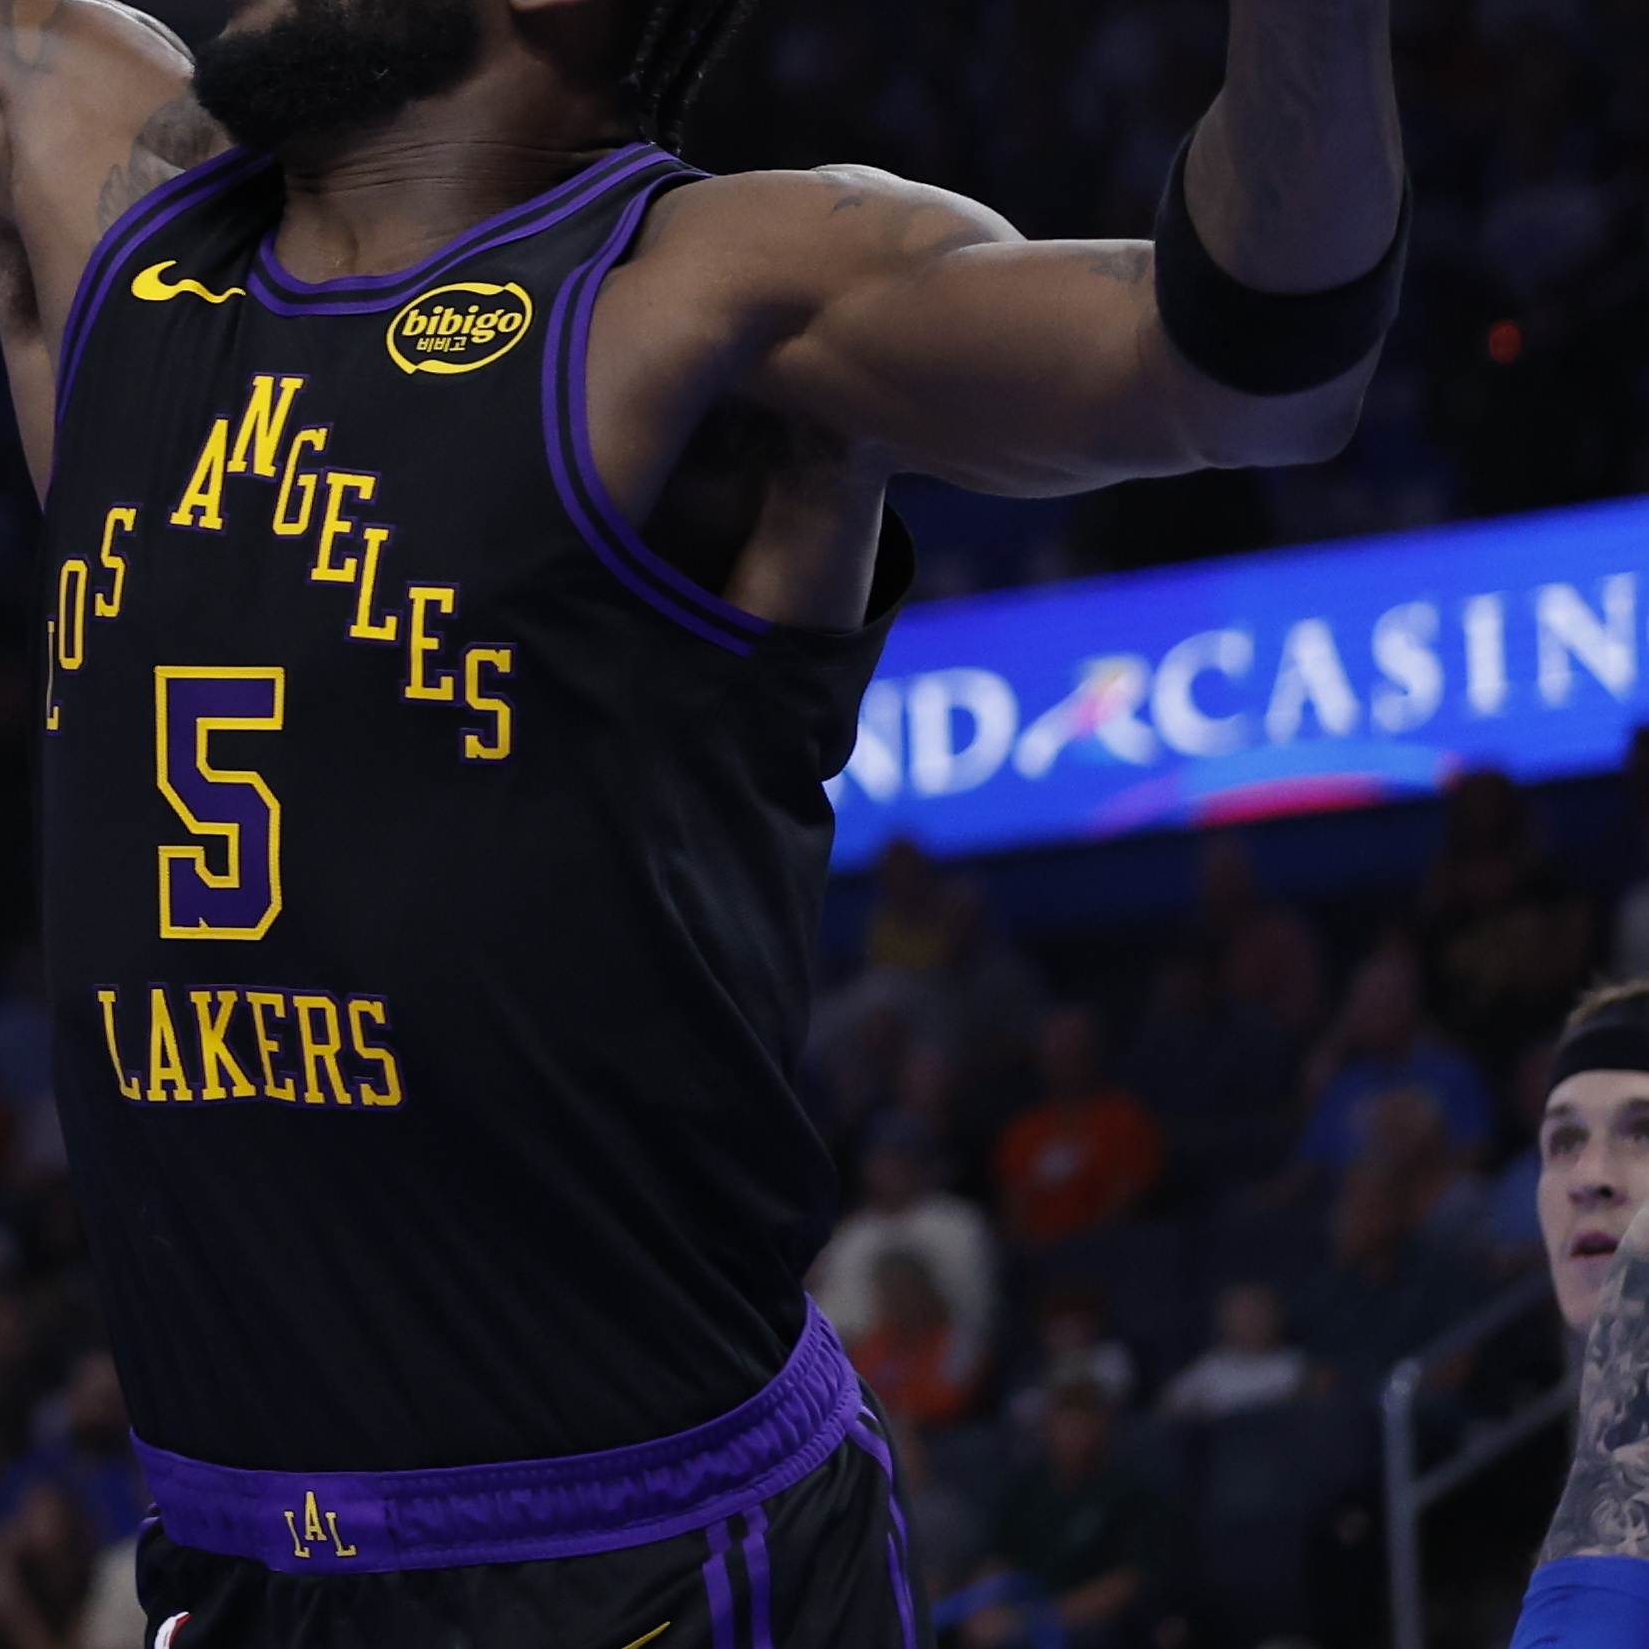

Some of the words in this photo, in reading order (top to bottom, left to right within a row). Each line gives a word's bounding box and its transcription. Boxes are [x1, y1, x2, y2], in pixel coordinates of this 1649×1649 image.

[402, 304, 523, 344] bibigo
[415, 336, 468, 353] 비비고
[46, 507, 138, 730] LOS
[170, 374, 515, 760] ANGELES
[1152, 570, 1649, 759] CASIN
[154, 665, 285, 941] 5
[98, 987, 404, 1108] LAKERS
[283, 1490, 358, 1559] LAL
